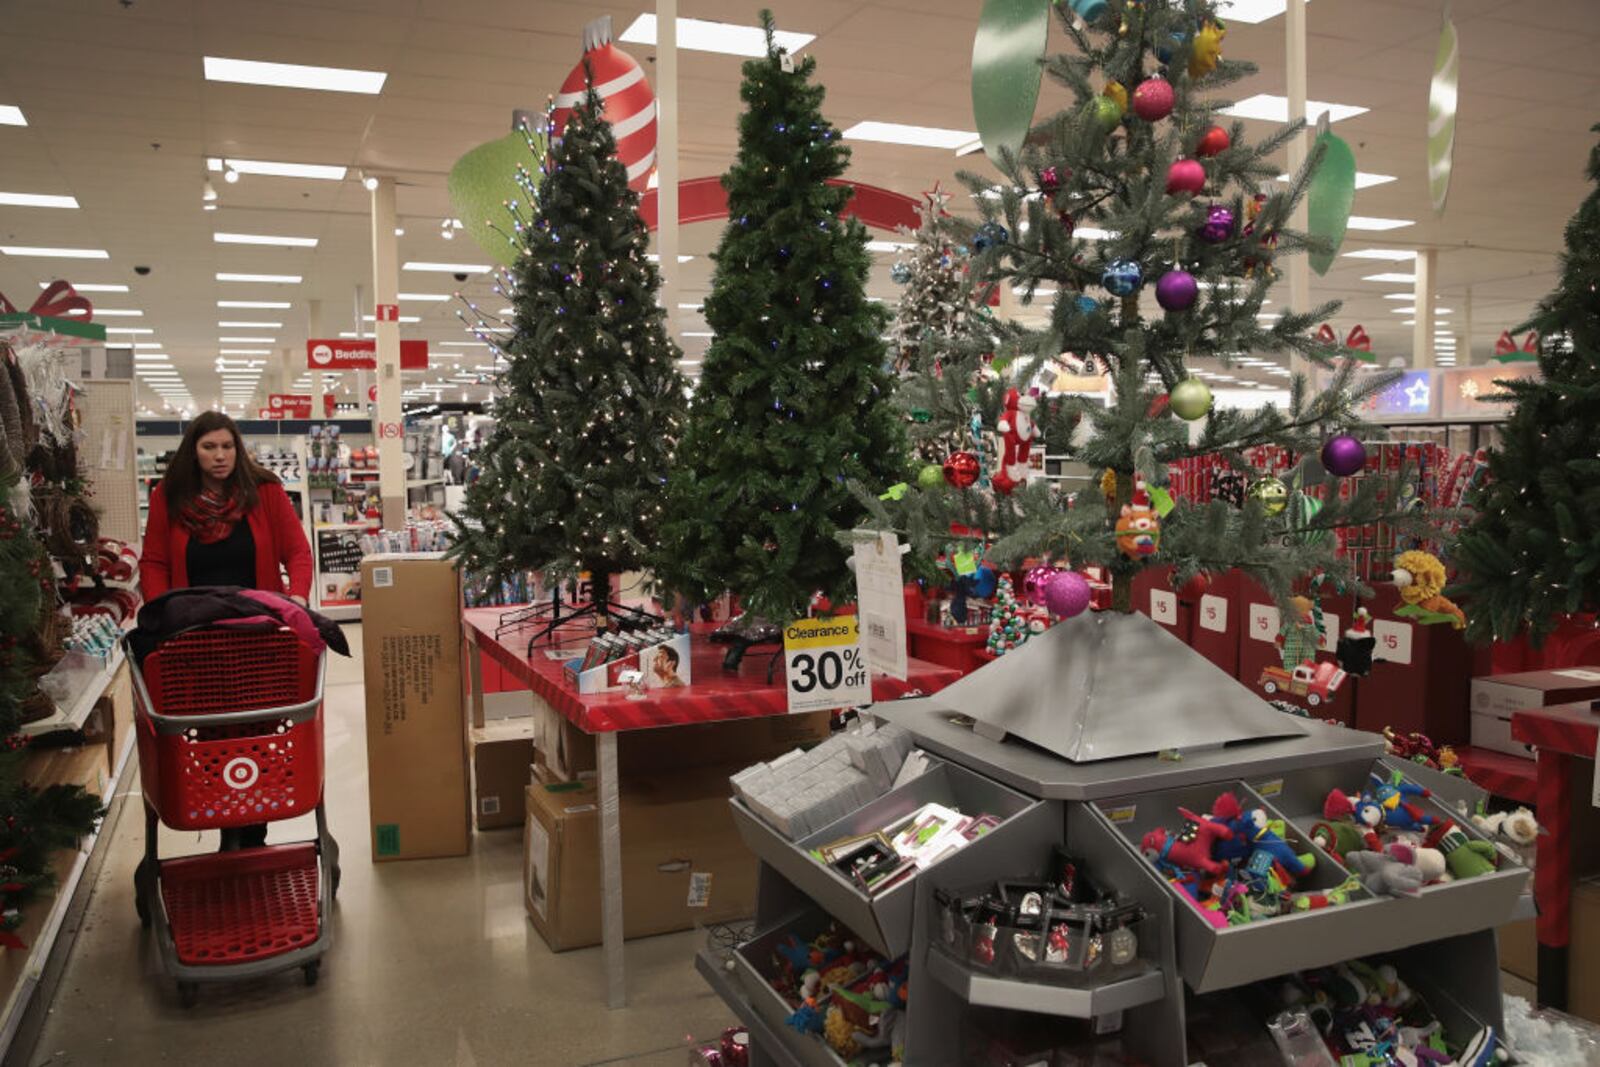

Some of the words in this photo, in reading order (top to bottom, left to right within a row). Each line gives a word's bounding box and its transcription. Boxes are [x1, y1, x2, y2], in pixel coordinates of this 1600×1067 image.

[1086, 360, 1094, 372] B
[786, 626, 848, 640] Clearance
[1383, 635, 1397, 648] $5
[844, 672, 866, 686] off
